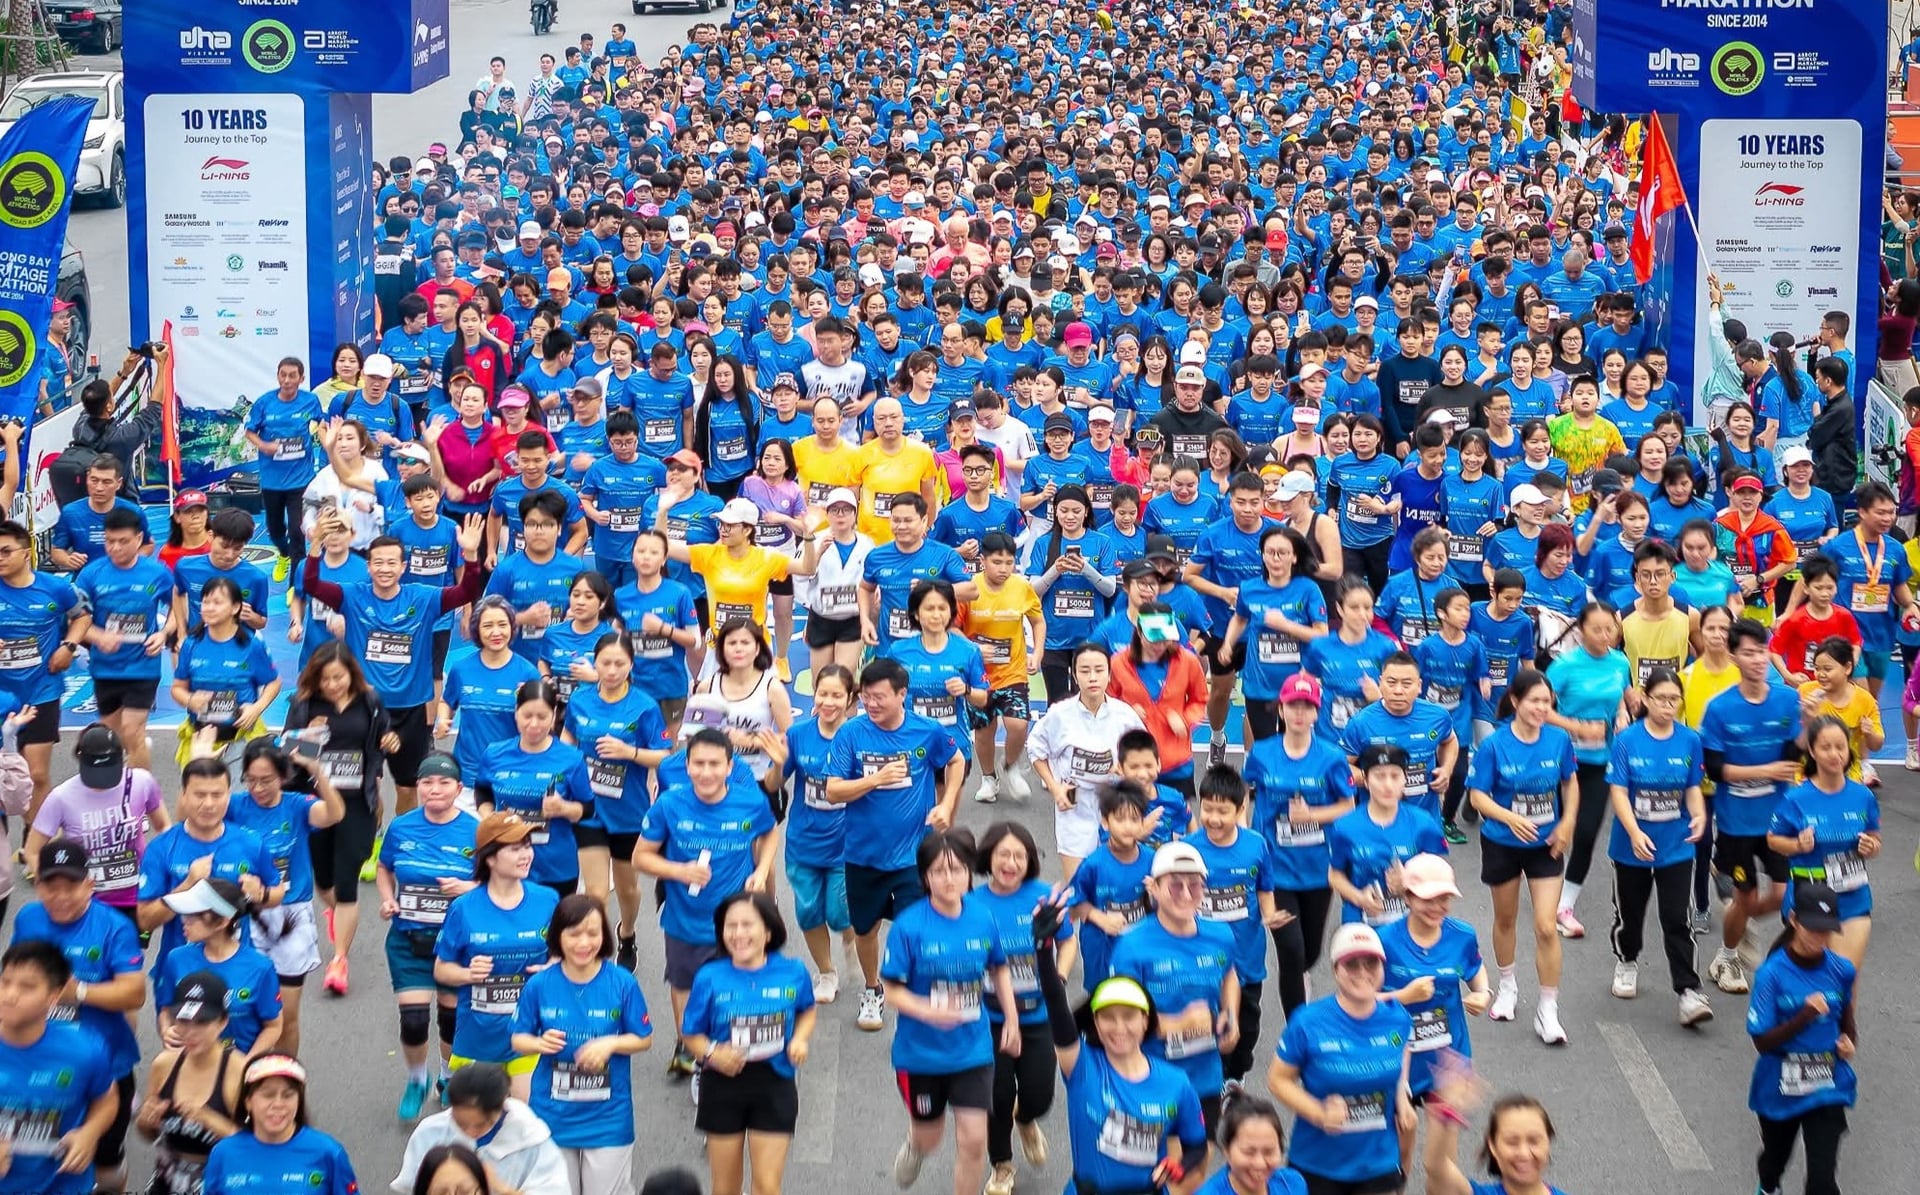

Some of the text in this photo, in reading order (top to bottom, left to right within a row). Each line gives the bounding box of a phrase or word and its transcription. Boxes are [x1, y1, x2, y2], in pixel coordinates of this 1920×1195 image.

[1707, 14, 1768, 28] SINCE 2014
[182, 109, 268, 130] 10 YEARS
[184, 134, 268, 145] Journey to the Top
[1738, 134, 1824, 155] 10 YEARS
[1740, 160, 1776, 170] Journey
[1790, 160, 1804, 168] the
[1807, 160, 1824, 170] Top
[201, 172, 250, 181] LI-NING
[8, 201, 40, 211] ATHLETICS
[1754, 198, 1805, 206] LI-NING
[29, 256, 51, 268] BAY
[1069, 600, 1090, 608] 50064
[82, 824, 138, 849] THE LIFE
[109, 864, 135, 877] 56185
[493, 988, 520, 1000] 51021
